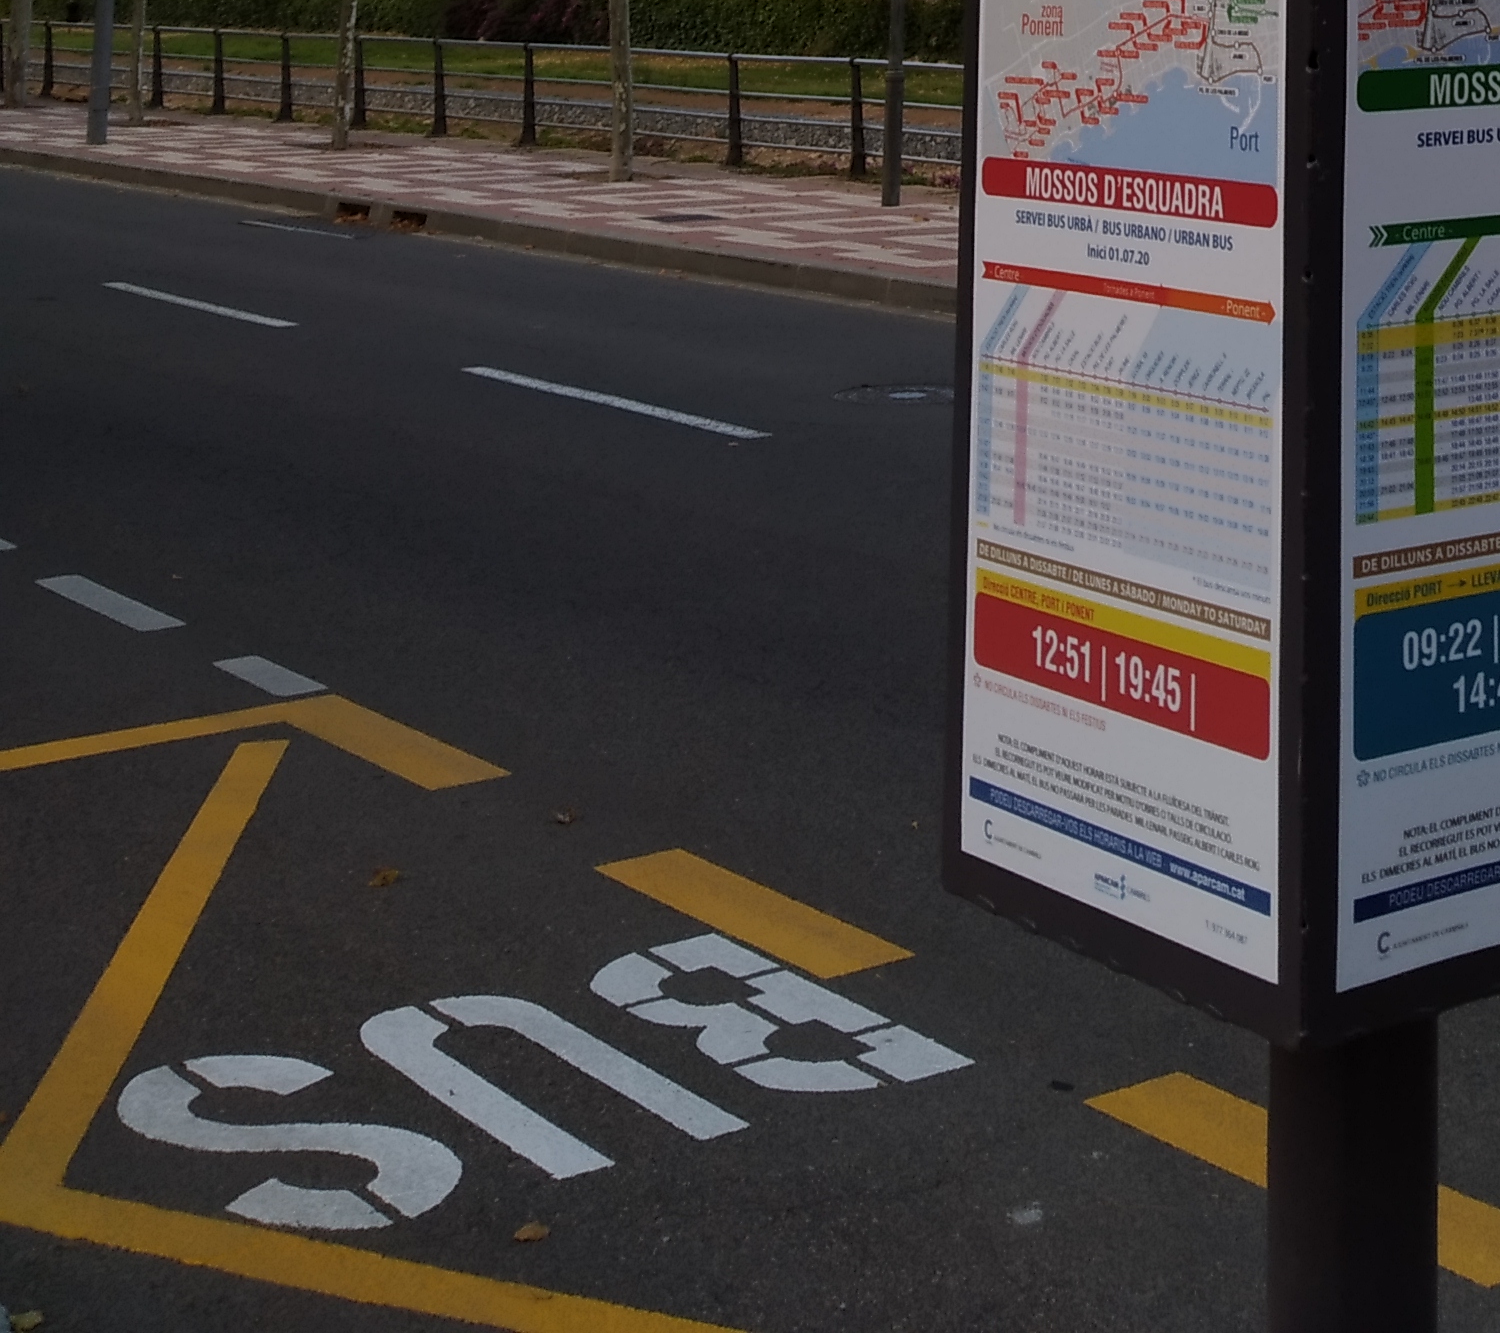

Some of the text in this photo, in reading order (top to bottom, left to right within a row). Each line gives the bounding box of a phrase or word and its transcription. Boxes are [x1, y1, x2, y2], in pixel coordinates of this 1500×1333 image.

[1021, 13, 1063, 36] Ponent
[1041, 5, 1062, 18] zona
[1229, 126, 1259, 152] Port
[1417, 128, 1463, 147] SERVEI
[1467, 127, 1493, 144] BUS
[1025, 165, 1224, 219] MOSSOS D'ESQUADRA
[1015, 209, 1045, 226] SERVEI
[1047, 213, 1065, 229] BUS
[1067, 213, 1092, 232] URBÀ
[1102, 220, 1121, 236] BUS
[1123, 223, 1165, 242] URBANO
[1174, 229, 1209, 247] URBAN
[1212, 234, 1232, 250] BUS
[1402, 223, 1444, 241] Centre
[1087, 244, 1149, 266] Inici 01.07.20
[994, 265, 1019, 281] Centre
[1226, 299, 1260, 319] Ponent
[1362, 556, 1377, 572] DE
[1381, 547, 1432, 569] DILLUNS
[1435, 545, 1443, 559] A
[1446, 535, 1500, 557] DISSABTE
[979, 542, 989, 557] DE
[990, 546, 1021, 566] DILLUNS
[1023, 555, 1028, 568] A
[1031, 557, 1066, 579] DISSABTE
[1073, 569, 1083, 584] DE
[1085, 572, 1109, 591] LUNES
[1111, 579, 1119, 594] A
[1120, 580, 1155, 604] SÁBADO
[1162, 593, 1201, 618] MONDAY
[1204, 605, 1215, 621] TO
[1217, 609, 1266, 636] SATURDAY
[1010, 584, 1038, 605] CENTRE,
[1041, 593, 1059, 611] PORT
[1066, 600, 1094, 621] PONENT
[1366, 585, 1410, 607] Direcció
[1413, 579, 1441, 598] PORT
[1402, 617, 1482, 671] 09:22
[1031, 623, 1181, 714] 12:51 19:45
[1373, 768, 1385, 782] NO
[1388, 758, 1427, 779] CIRCULA
[1429, 754, 1445, 769] ELS
[1447, 743, 1494, 765] DISSABTES
[1429, 820, 1438, 833] EL
[1440, 807, 1493, 830] COMPLIMENT
[1399, 844, 1408, 857] EL
[1410, 831, 1463, 854] RECORREGUT
[1465, 828, 1474, 841] ES
[1476, 824, 1491, 838] POT
[1361, 869, 1376, 884] ELS
[1379, 858, 1420, 879] DIMECRES
[1422, 854, 1432, 868] AL
[1458, 846, 1467, 859] EL
[1469, 841, 1485, 856] BUS
[1487, 837, 1499, 852] NO
[1169, 860, 1244, 903] www.aparcam.cat
[1389, 885, 1423, 908] PODEU
[117, 933, 976, 1230] BUS
